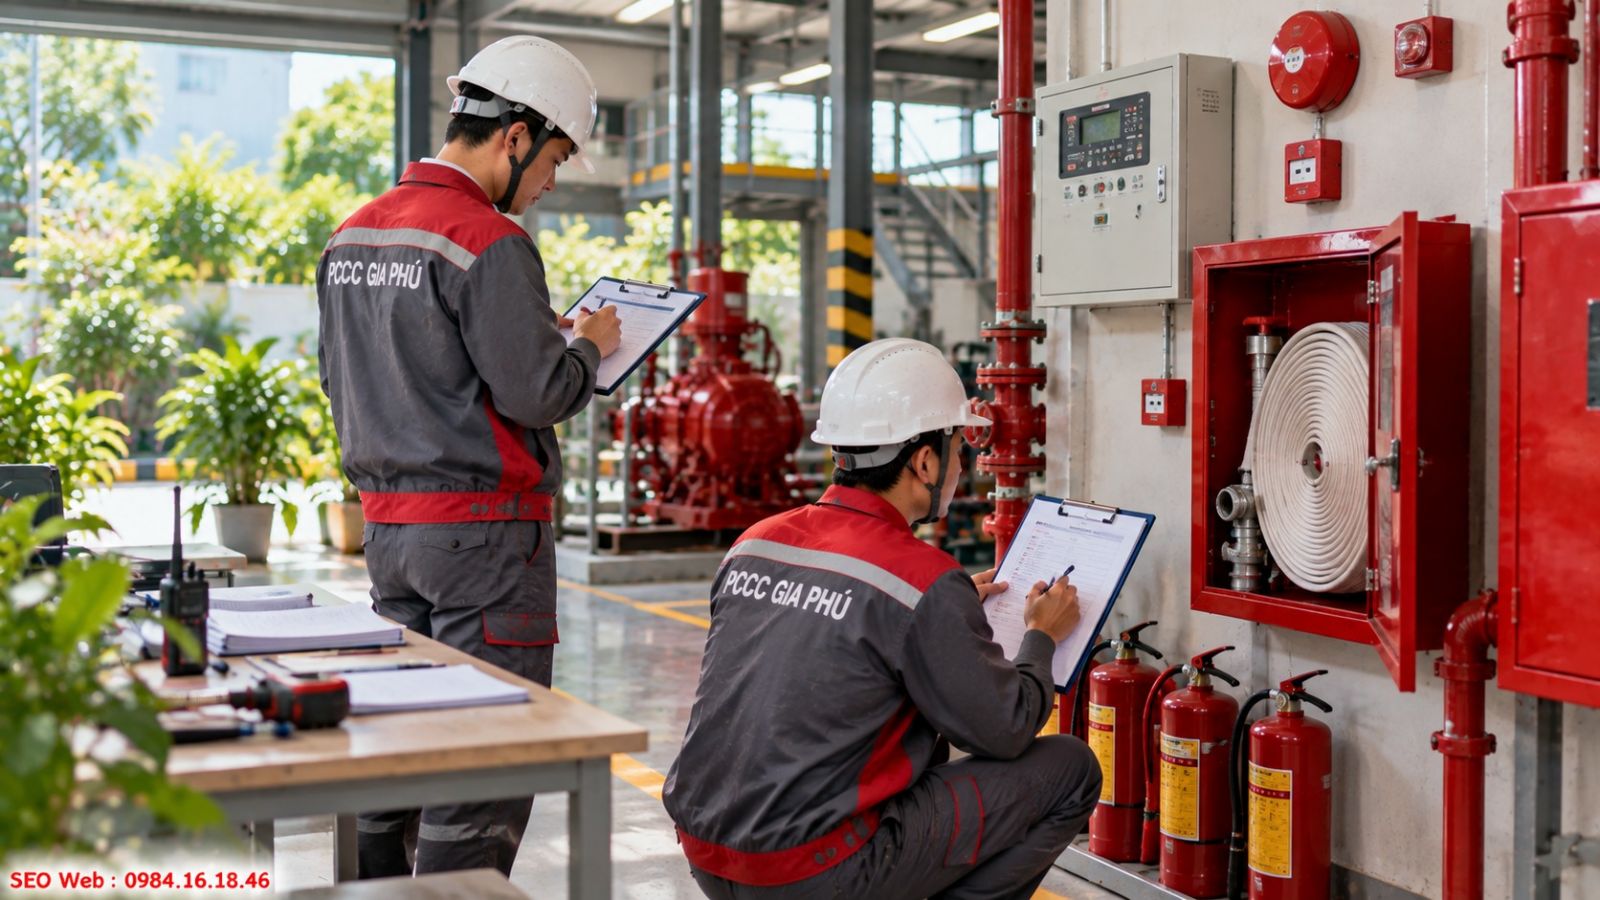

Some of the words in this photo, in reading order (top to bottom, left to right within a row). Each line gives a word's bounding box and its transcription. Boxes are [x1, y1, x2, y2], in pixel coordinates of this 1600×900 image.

[327, 260, 363, 286] PCCC
[366, 262, 386, 286] GIA
[388, 259, 422, 289] PHÚ
[723, 570, 771, 600] PCCC
[771, 580, 804, 608] GIA
[802, 586, 852, 620] PHÚ
